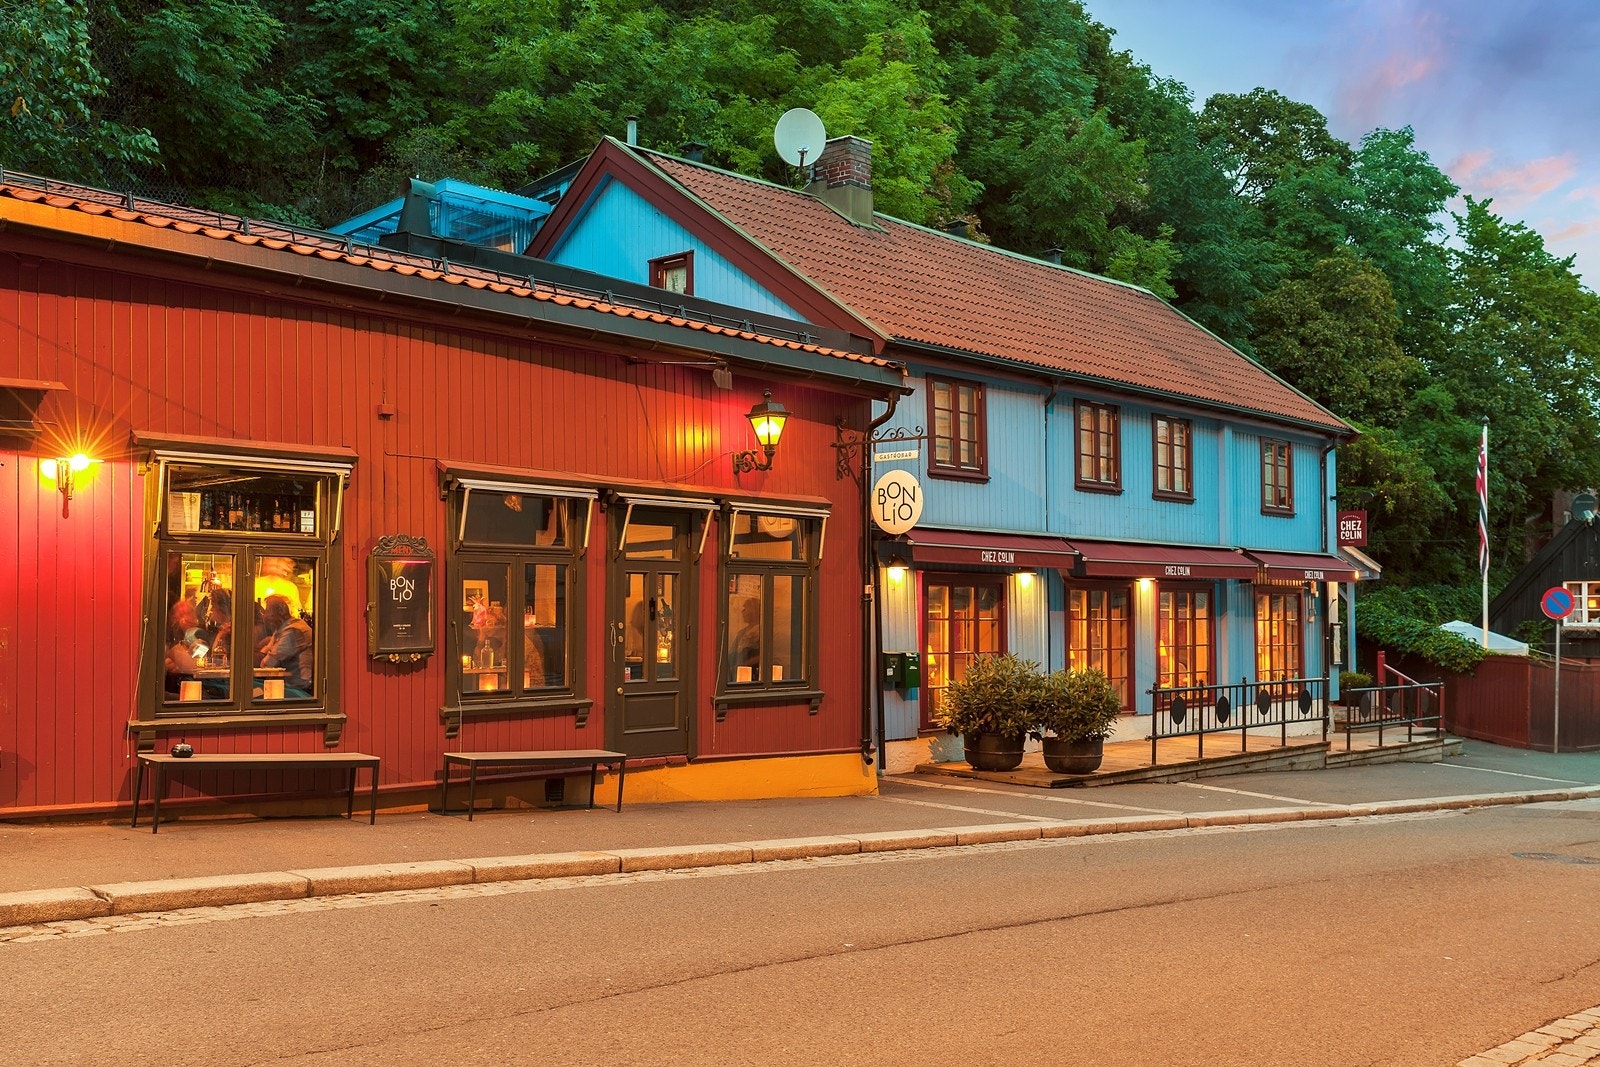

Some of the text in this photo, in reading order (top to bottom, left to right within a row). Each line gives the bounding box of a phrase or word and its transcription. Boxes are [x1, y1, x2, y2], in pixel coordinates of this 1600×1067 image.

[879, 451, 912, 460] GASTROBAR
[878, 481, 916, 505] BON
[1340, 520, 1362, 531] CHEZ
[981, 550, 996, 563] CHEZ
[1165, 566, 1177, 576] CHEZ
[390, 575, 415, 591] BON
